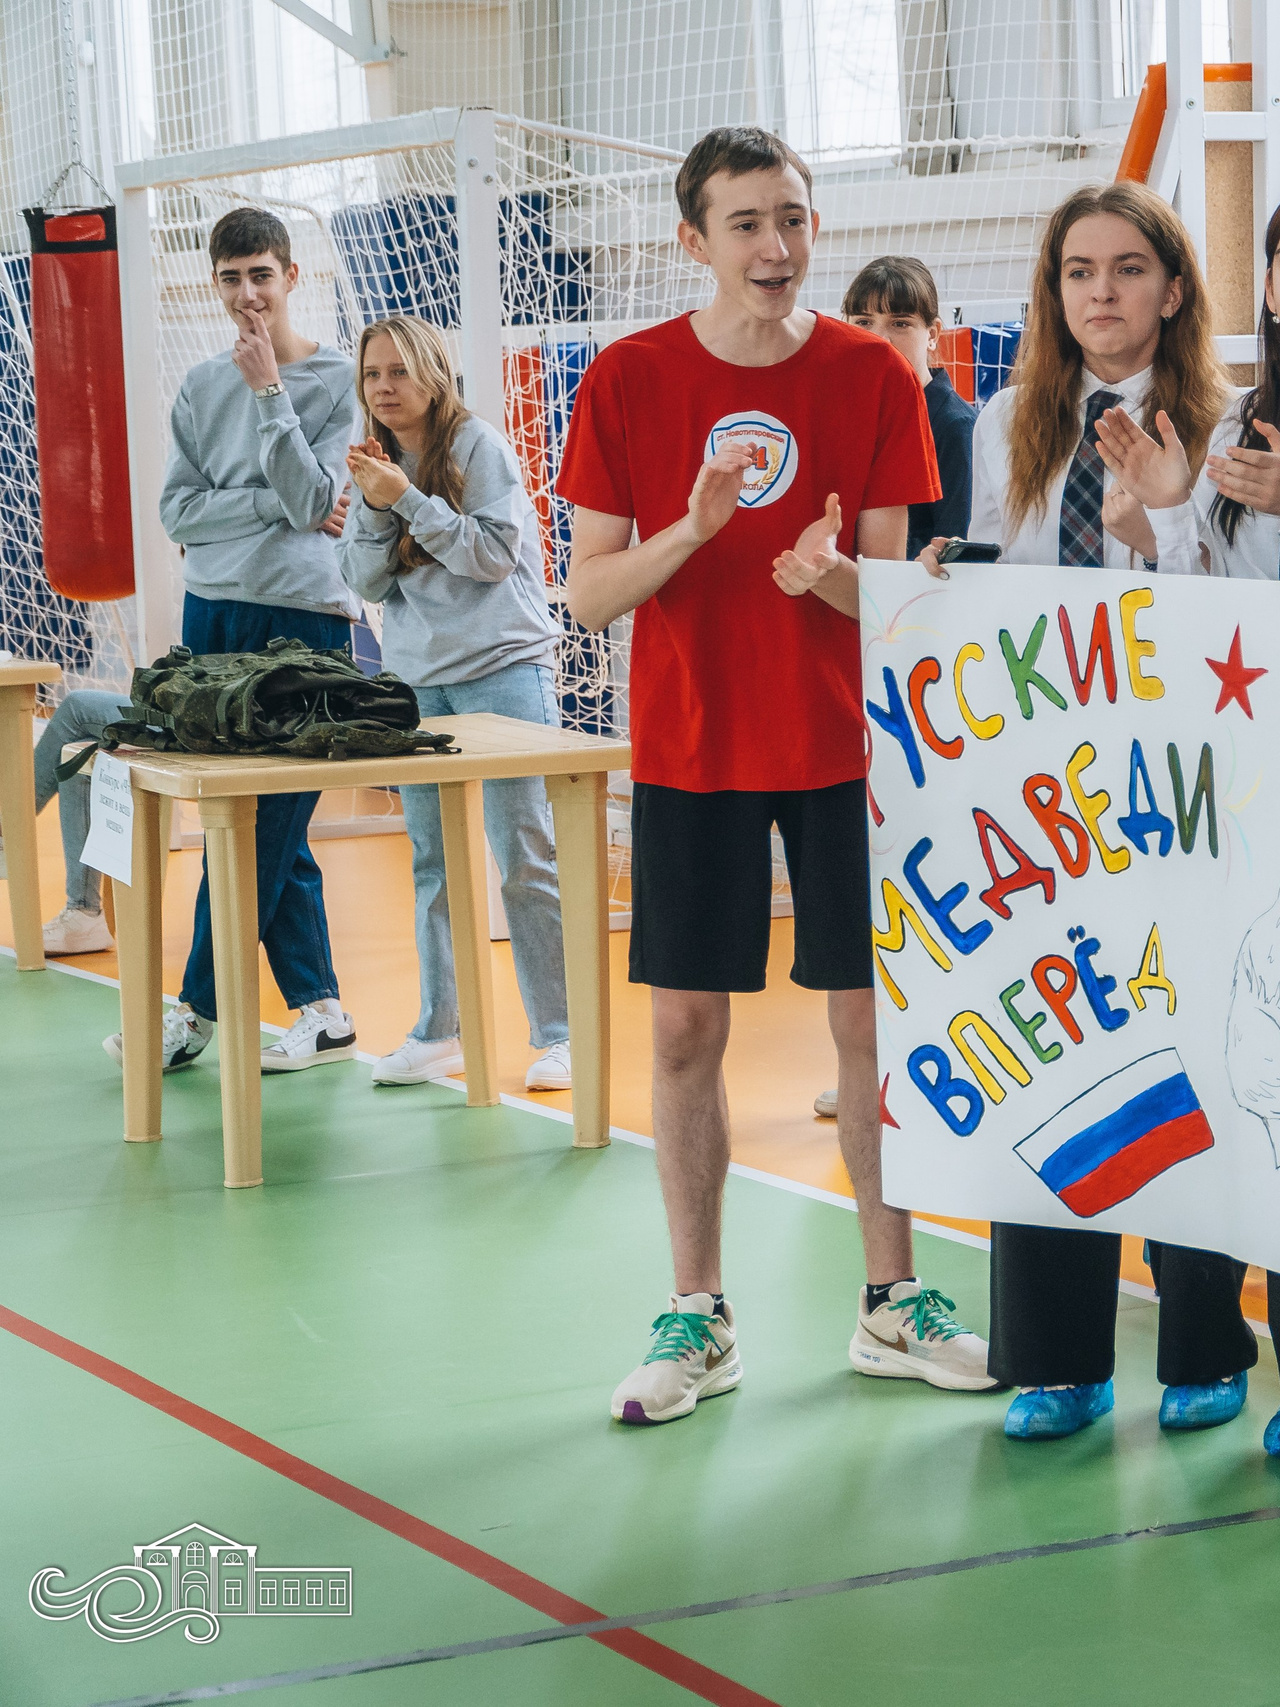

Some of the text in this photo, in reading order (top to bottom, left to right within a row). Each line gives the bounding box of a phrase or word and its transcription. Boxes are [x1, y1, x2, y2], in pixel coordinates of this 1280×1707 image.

[739, 483, 765, 491] КОЛА
[872, 738, 1219, 1011] МЕДВЕДИ
[907, 921, 1177, 1137] ВПЕРЁД
